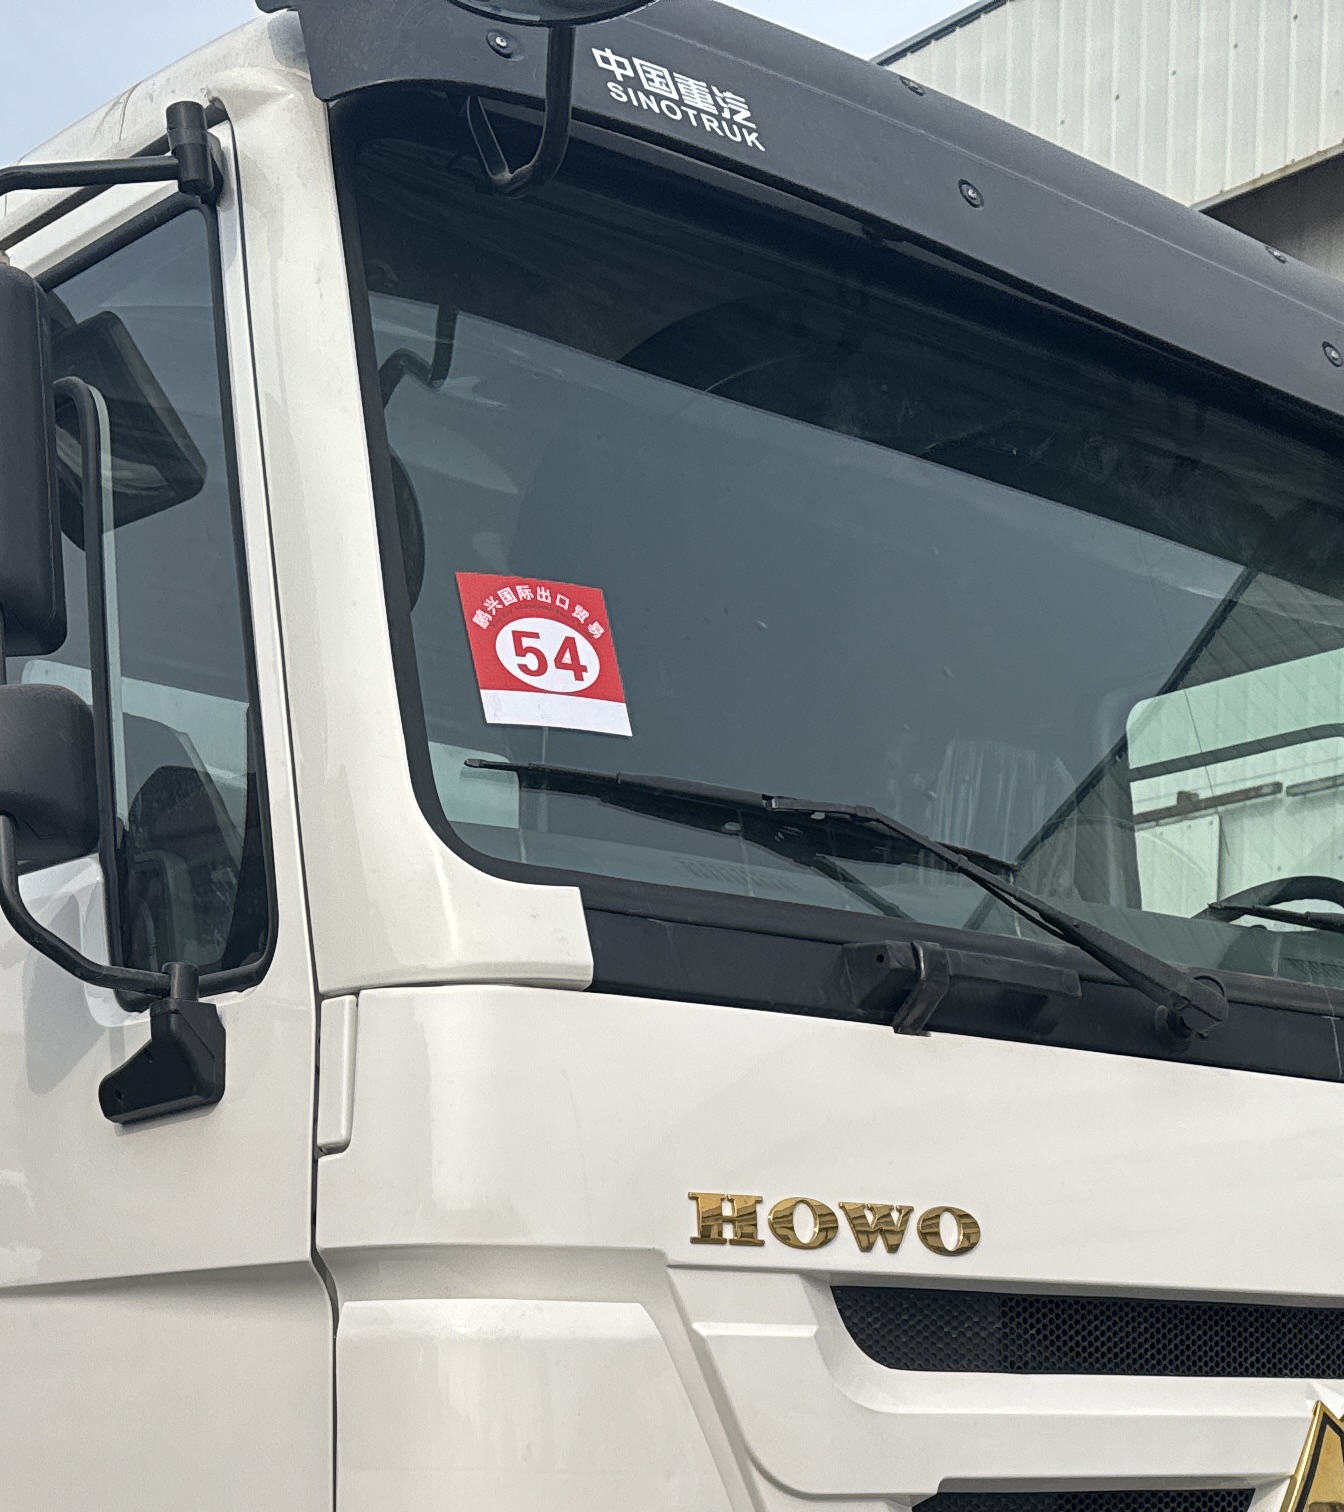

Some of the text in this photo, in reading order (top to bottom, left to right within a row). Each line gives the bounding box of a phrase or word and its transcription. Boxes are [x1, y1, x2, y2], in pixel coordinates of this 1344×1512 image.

[592, 47, 757, 129] 中国重汽
[607, 81, 766, 152] SINOTRUK
[511, 630, 588, 682] 54
[687, 1191, 981, 1257] HOWO
